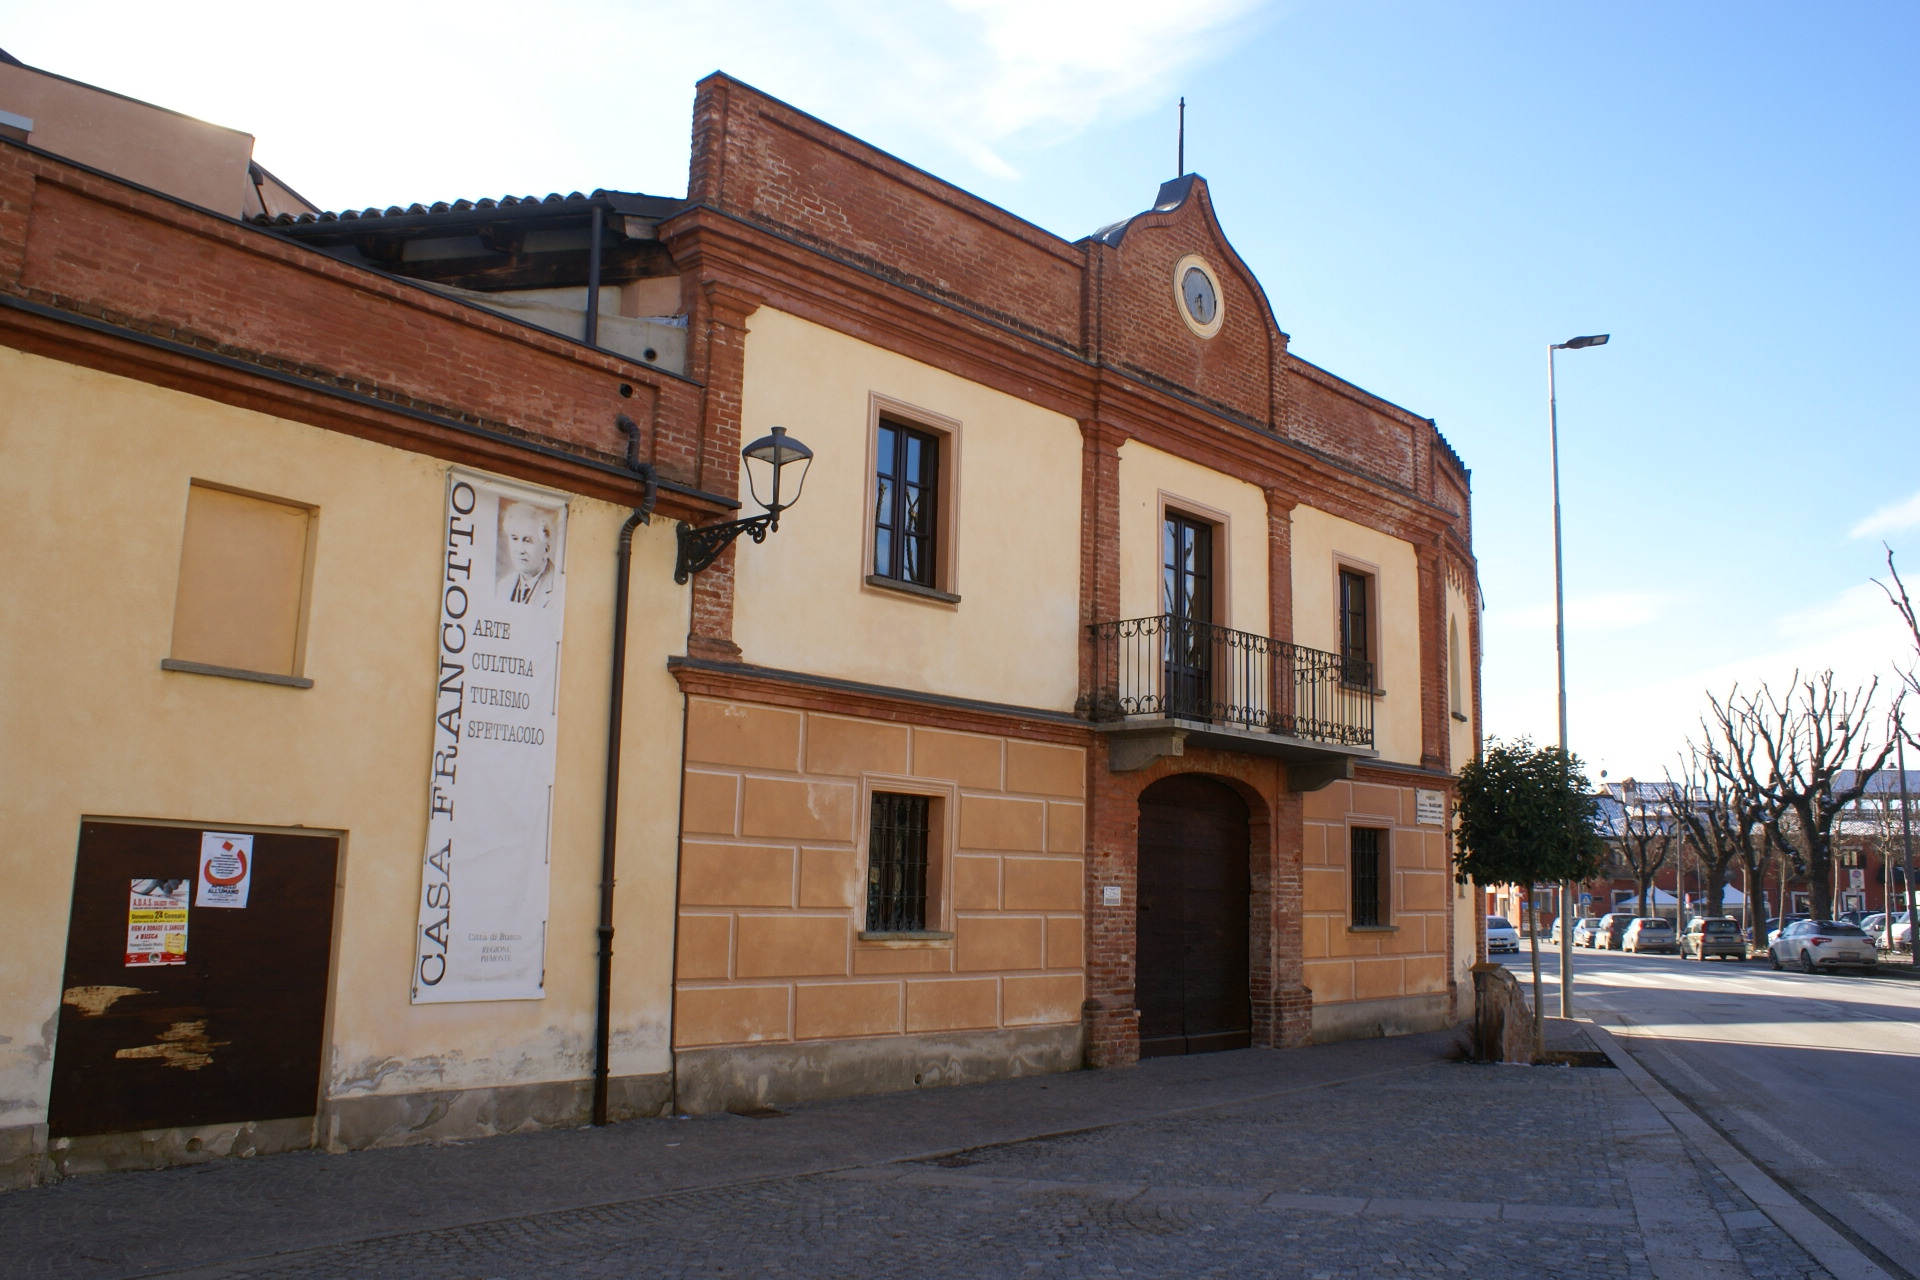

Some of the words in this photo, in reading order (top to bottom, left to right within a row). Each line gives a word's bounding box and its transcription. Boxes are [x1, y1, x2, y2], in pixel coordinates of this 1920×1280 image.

[472, 619, 511, 640] ARTE
[431, 481, 476, 822] FRANCOTTO
[472, 652, 534, 677] CULTURA
[470, 686, 530, 710] TURISMO
[467, 720, 545, 745] SPETTACOLO
[155, 911, 163, 919] 24
[420, 838, 452, 986] CASA
[490, 933, 497, 941] di
